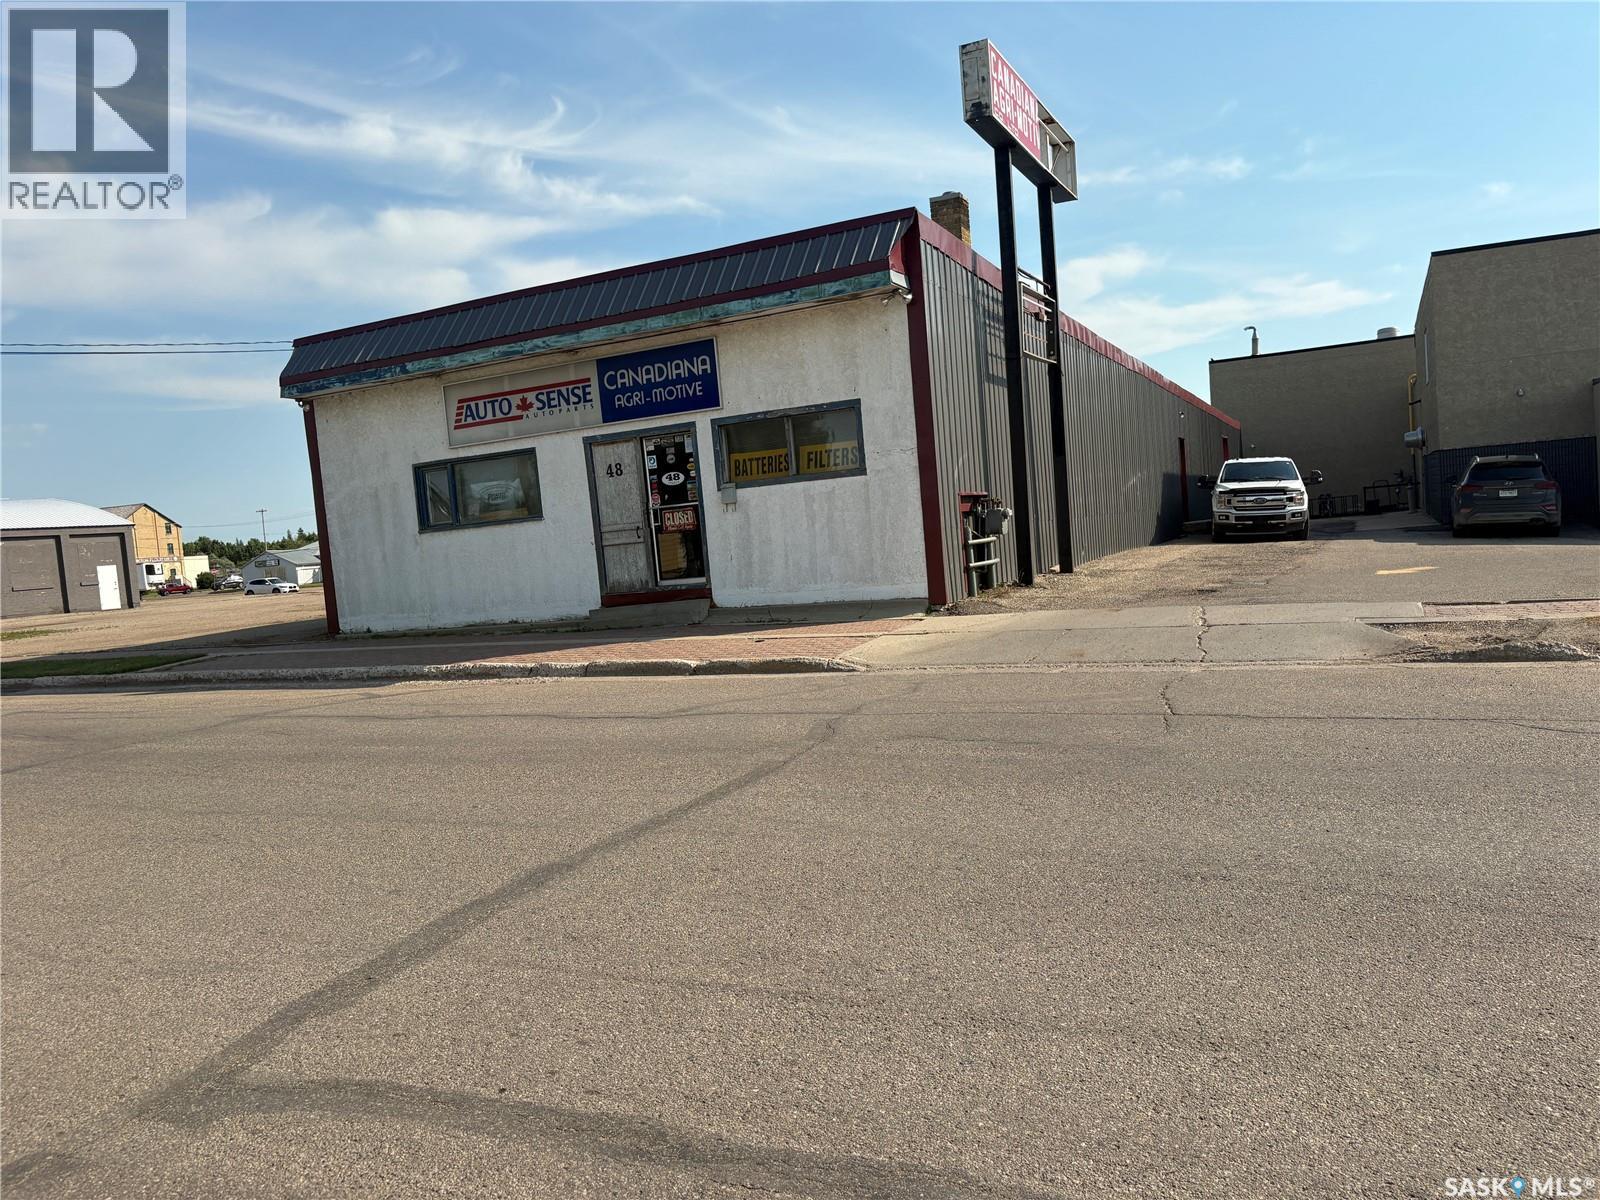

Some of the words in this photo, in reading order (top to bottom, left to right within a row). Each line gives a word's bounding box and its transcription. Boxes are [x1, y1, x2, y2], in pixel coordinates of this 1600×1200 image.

[603, 355, 712, 390] CANADIANA
[463, 397, 512, 422] AUTO
[535, 383, 593, 411] SENSE
[615, 381, 704, 409] AGRI-MOTIVE
[525, 404, 595, 419] AUTOPARTS
[606, 463, 624, 478] 48
[734, 453, 790, 477] BATTERIES
[806, 446, 858, 470] FILTERS
[665, 473, 681, 482] 48
[665, 510, 694, 526] CLOSED
